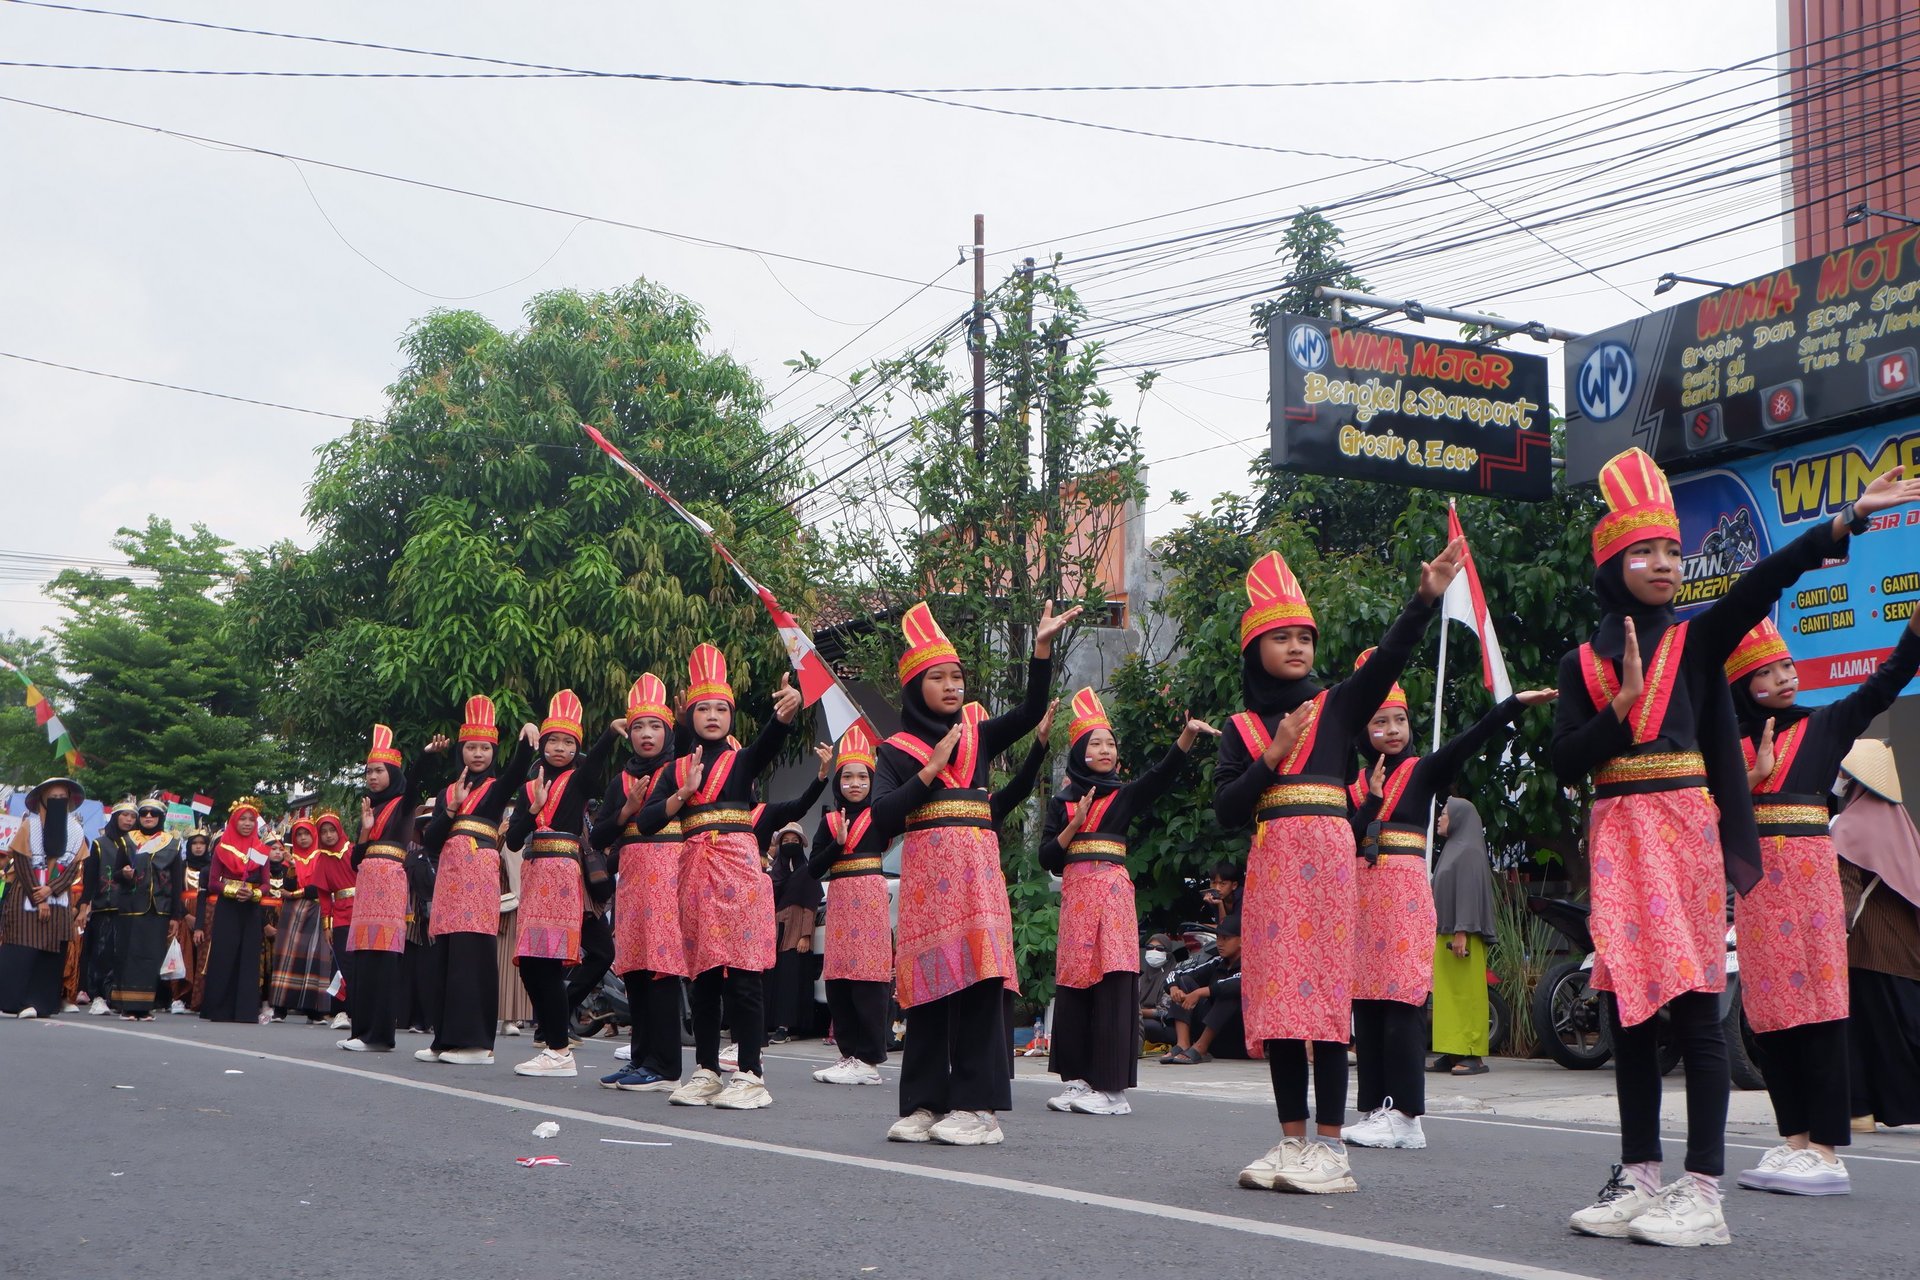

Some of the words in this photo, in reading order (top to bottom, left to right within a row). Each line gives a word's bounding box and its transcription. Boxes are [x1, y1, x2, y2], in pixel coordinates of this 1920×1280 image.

[1696, 270, 1801, 341] WIMA
[1816, 226, 1920, 304] MOT
[1753, 321, 1796, 349] Dan
[1330, 326, 1408, 376] WIMA
[1411, 341, 1514, 390] MOTOR
[1799, 352, 1839, 374] Tune
[1682, 360, 1720, 389] Ganti
[1304, 372, 1402, 422] Bengkel
[1418, 387, 1538, 429] Sparepart
[1682, 381, 1720, 407] Ganti
[1727, 376, 1755, 397] Ban
[1339, 425, 1406, 459] Grosir
[1407, 441, 1424, 467] &
[1425, 440, 1479, 471] Ecer
[1867, 512, 1901, 532] SIR
[1798, 589, 1828, 609] GANTI
[1830, 585, 1848, 602] OLI
[1883, 573, 1920, 595] GANTI
[1800, 614, 1830, 634] GANTI
[1832, 610, 1854, 629] BAN
[1829, 657, 1878, 680] ALAMAT
